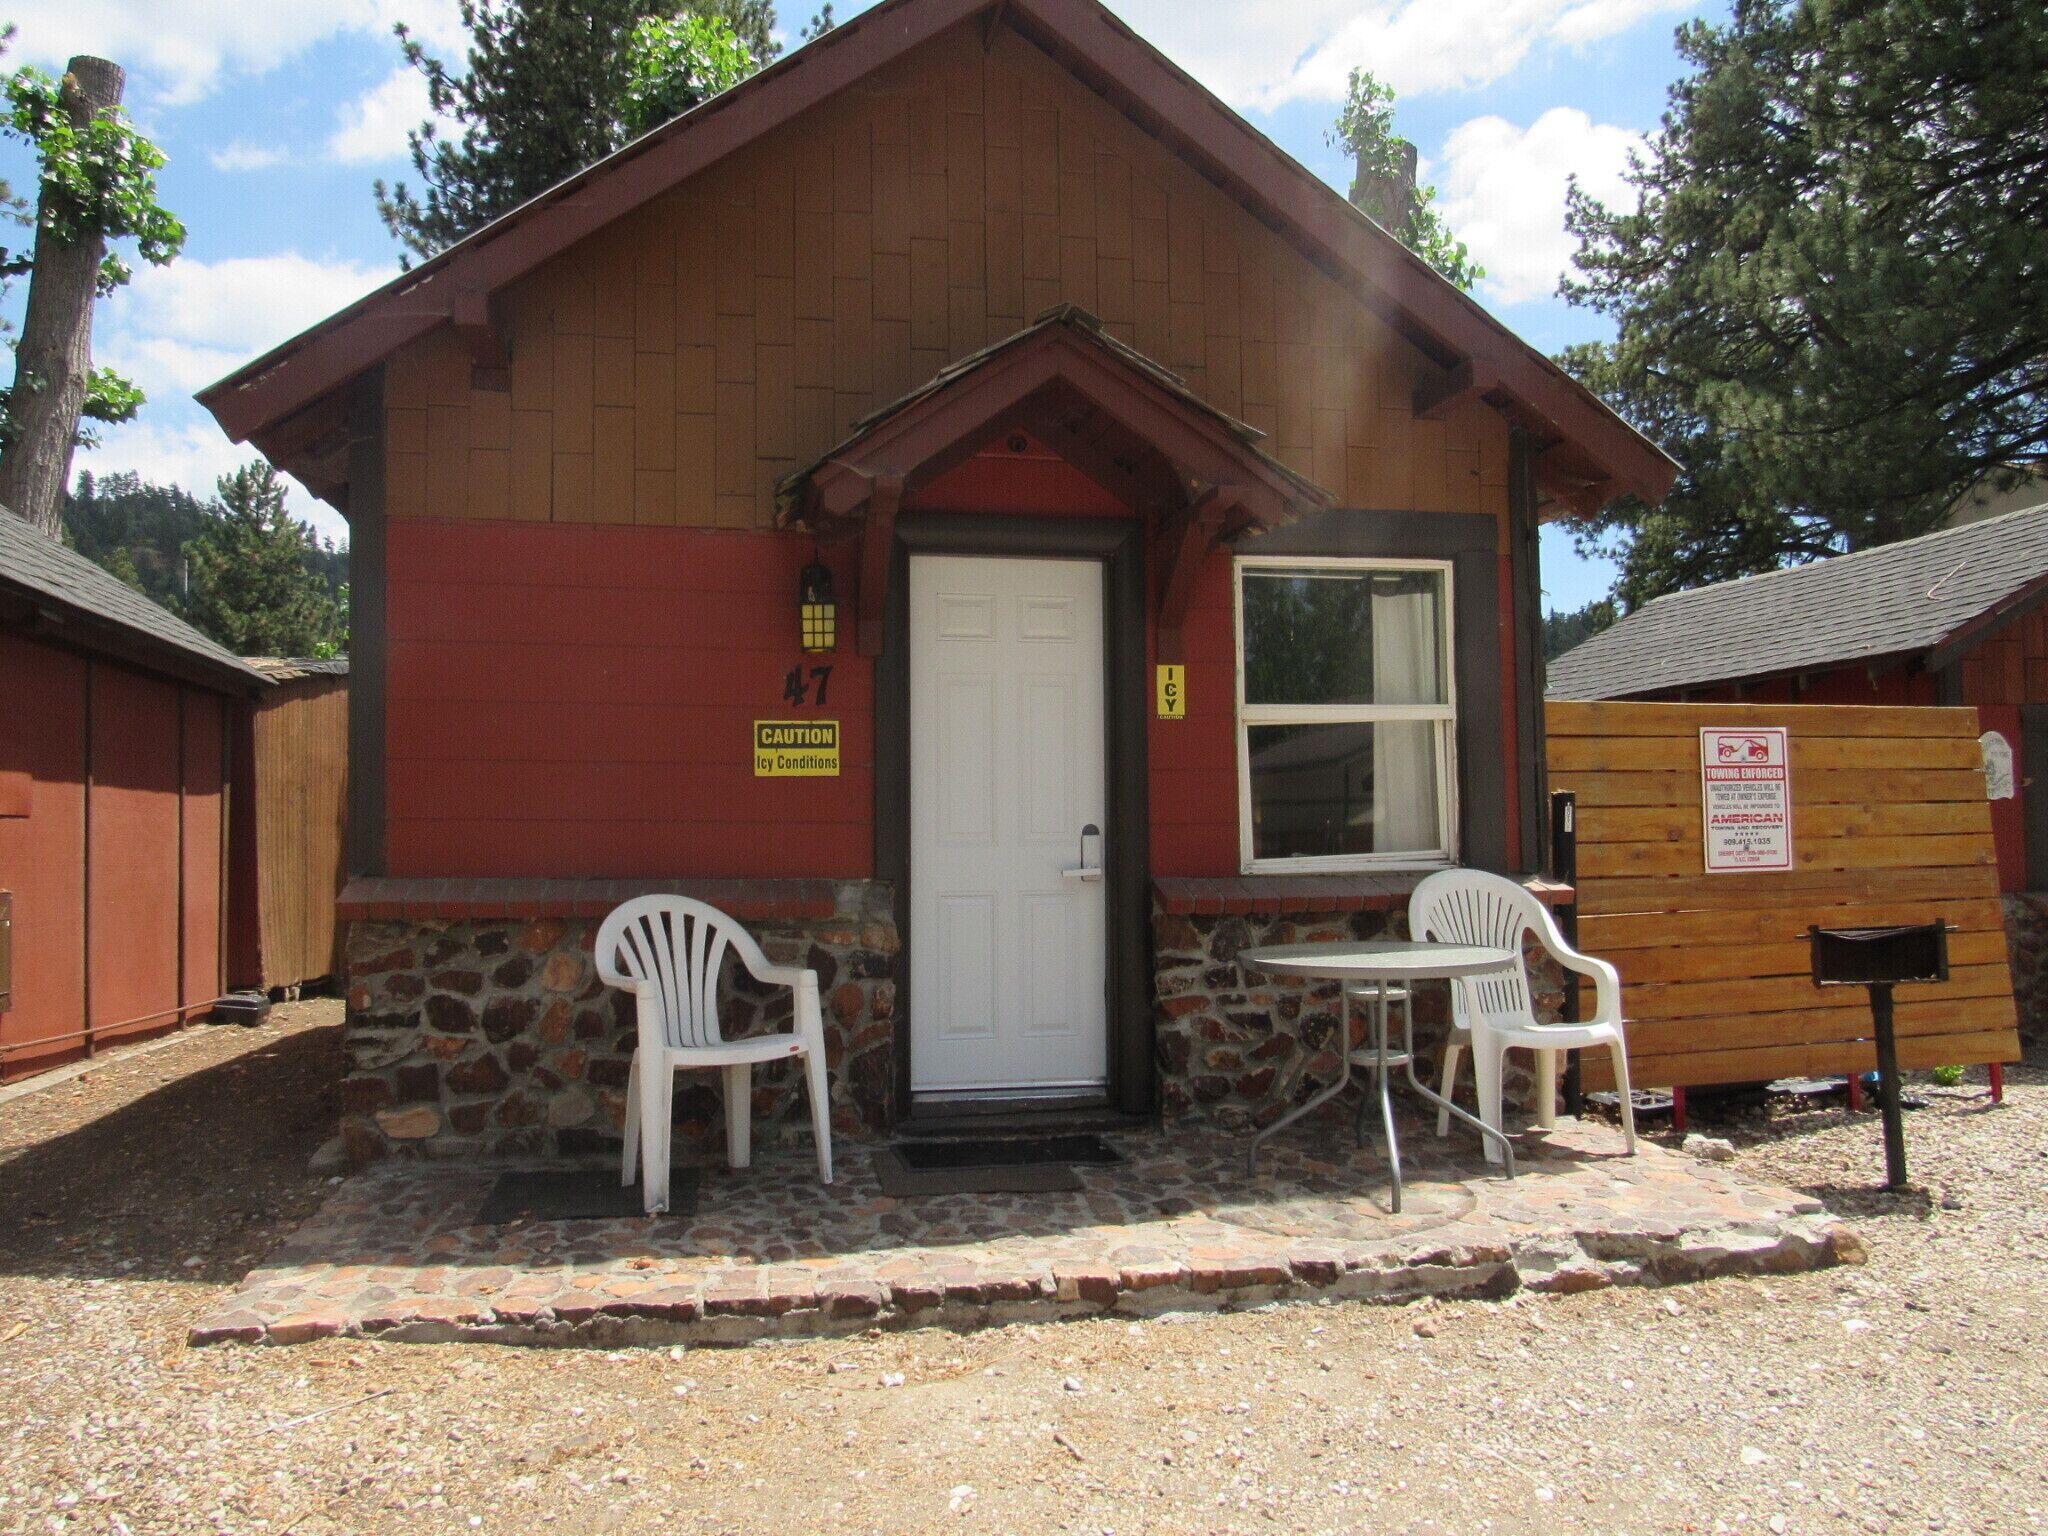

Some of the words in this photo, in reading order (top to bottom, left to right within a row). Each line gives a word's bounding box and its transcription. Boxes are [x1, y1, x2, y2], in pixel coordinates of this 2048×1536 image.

[784, 664, 834, 706] 47
[1165, 668, 1177, 712] ICY
[761, 729, 833, 744] CAUTION
[757, 756, 773, 772] Icy
[777, 755, 837, 769] Conditions
[1706, 768, 1740, 779] TOWING
[1741, 767, 1783, 779] ENFORCED
[1757, 792, 1776, 800] EXPENSE
[1711, 813, 1783, 824] AMERICAN
